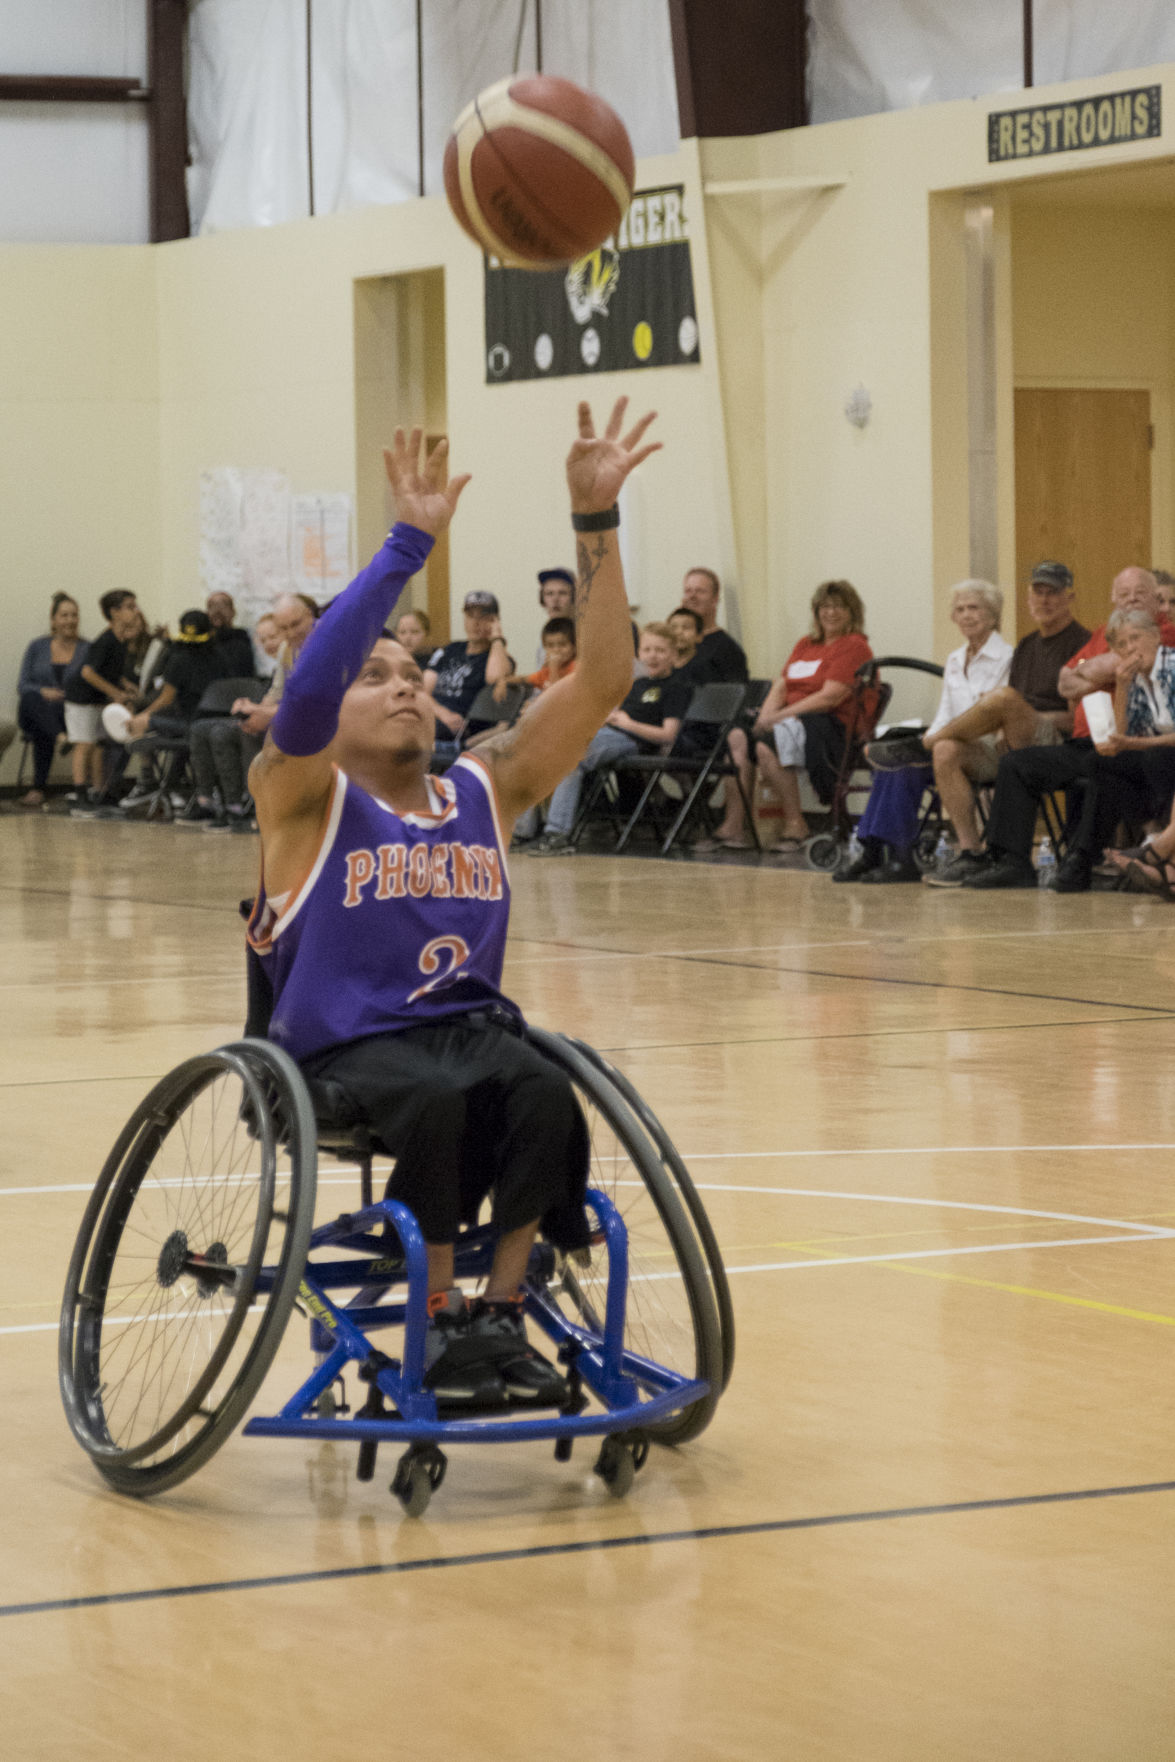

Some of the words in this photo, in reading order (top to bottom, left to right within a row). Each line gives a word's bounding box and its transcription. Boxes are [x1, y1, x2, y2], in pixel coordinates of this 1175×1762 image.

[1000, 92, 1149, 158] RESTROOMS
[601, 191, 690, 251] IGER
[407, 935, 471, 1004] 2
